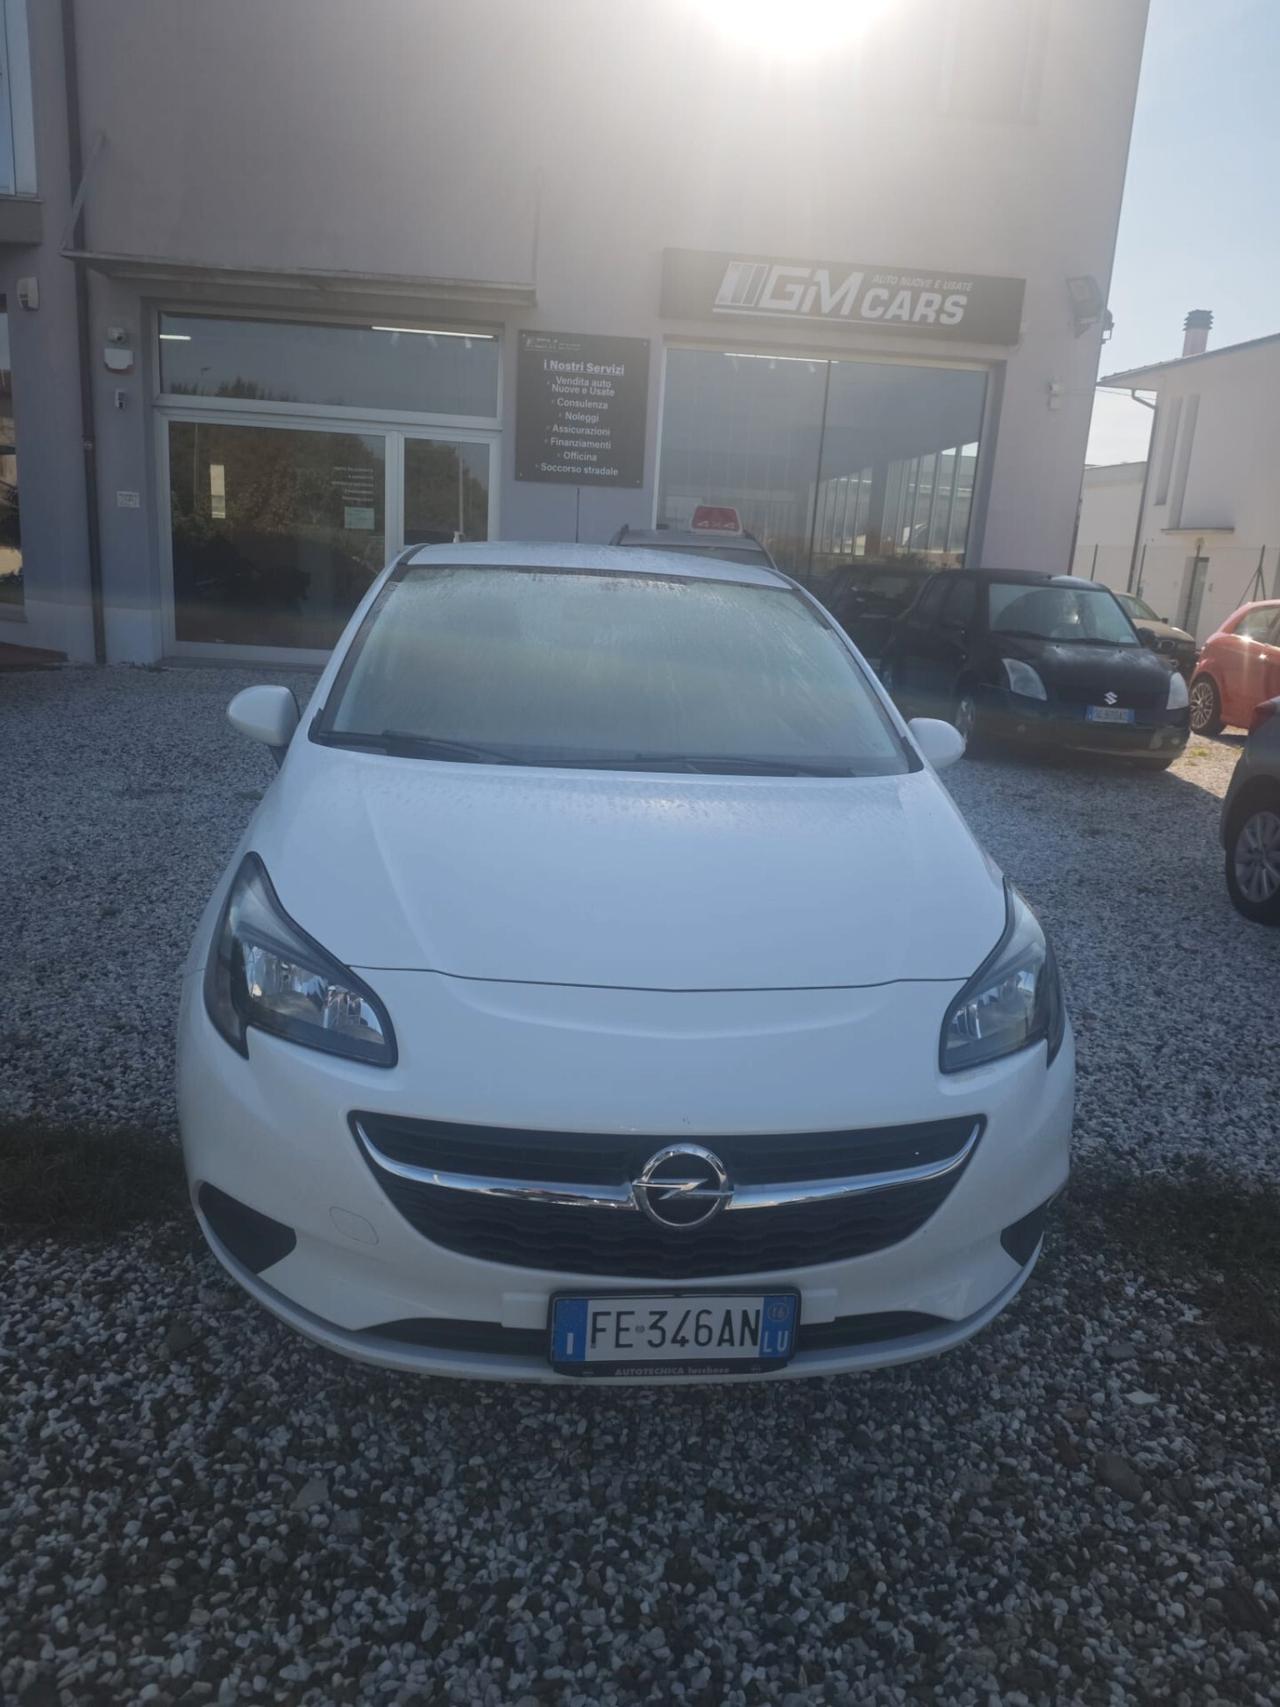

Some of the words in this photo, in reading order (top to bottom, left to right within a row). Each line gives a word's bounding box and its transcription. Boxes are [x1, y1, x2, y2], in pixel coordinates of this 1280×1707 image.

[872, 273, 897, 285] AUTO
[900, 276, 932, 289] NUOVE
[934, 279, 942, 290] E
[943, 280, 974, 292] USATE
[860, 287, 968, 325] CARS
[550, 360, 584, 372] Nostri
[586, 363, 625, 375] Servizi
[556, 376, 589, 387] Vendita
[591, 380, 612, 388] auto
[552, 384, 580, 395] Nuove
[590, 387, 615, 397] Usate
[556, 398, 608, 410] Consulenza
[565, 412, 599, 423] Noleggi
[552, 424, 611, 437] Assicurazioni
[550, 437, 612, 449] Finanziamenti
[563, 451, 598, 462] Officina
[540, 463, 582, 474] Soccorso
[584, 466, 619, 477] stradale
[763, 1330, 789, 1353] LU
[615, 1367, 685, 1376] AUTOTECNICA
